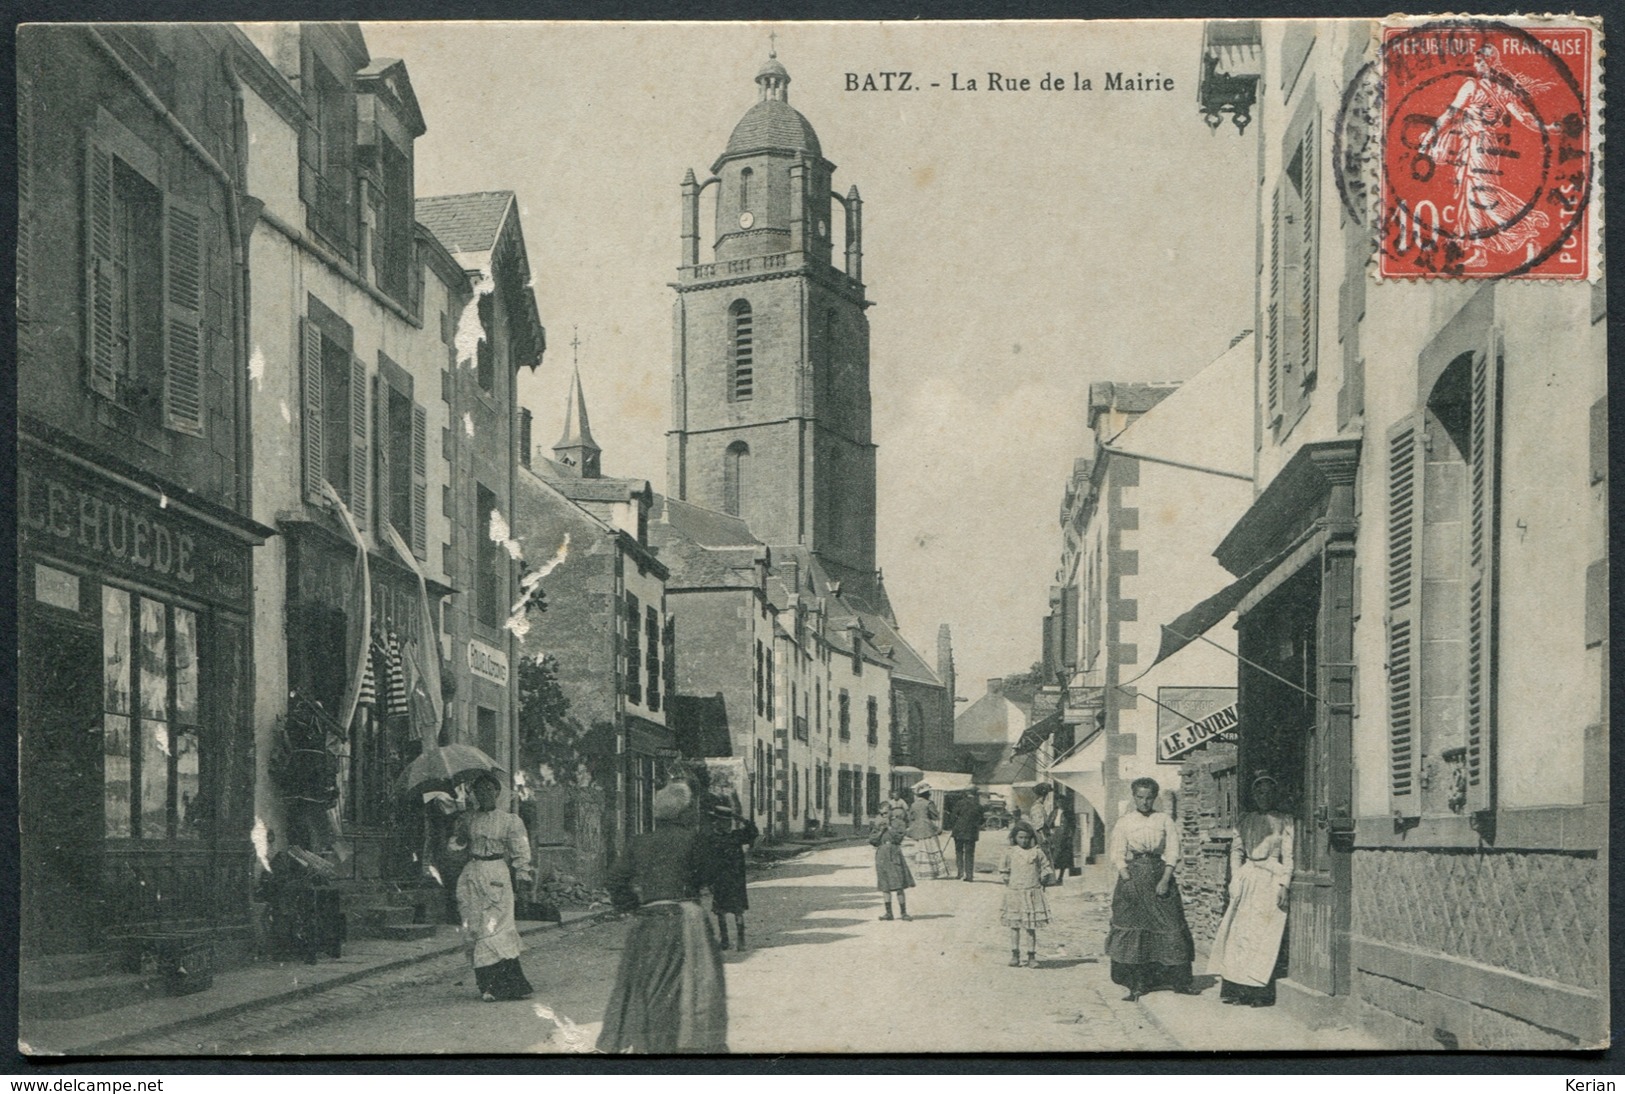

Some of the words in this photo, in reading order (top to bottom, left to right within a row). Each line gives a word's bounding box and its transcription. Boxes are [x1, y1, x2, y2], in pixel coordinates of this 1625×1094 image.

[844, 72, 920, 92] BATZ.
[951, 73, 978, 91] La
[987, 72, 1031, 92] Rue
[1039, 72, 1065, 92] de
[1073, 72, 1093, 91] la
[1104, 72, 1175, 91] Mairie
[1162, 731, 1186, 755] LE
